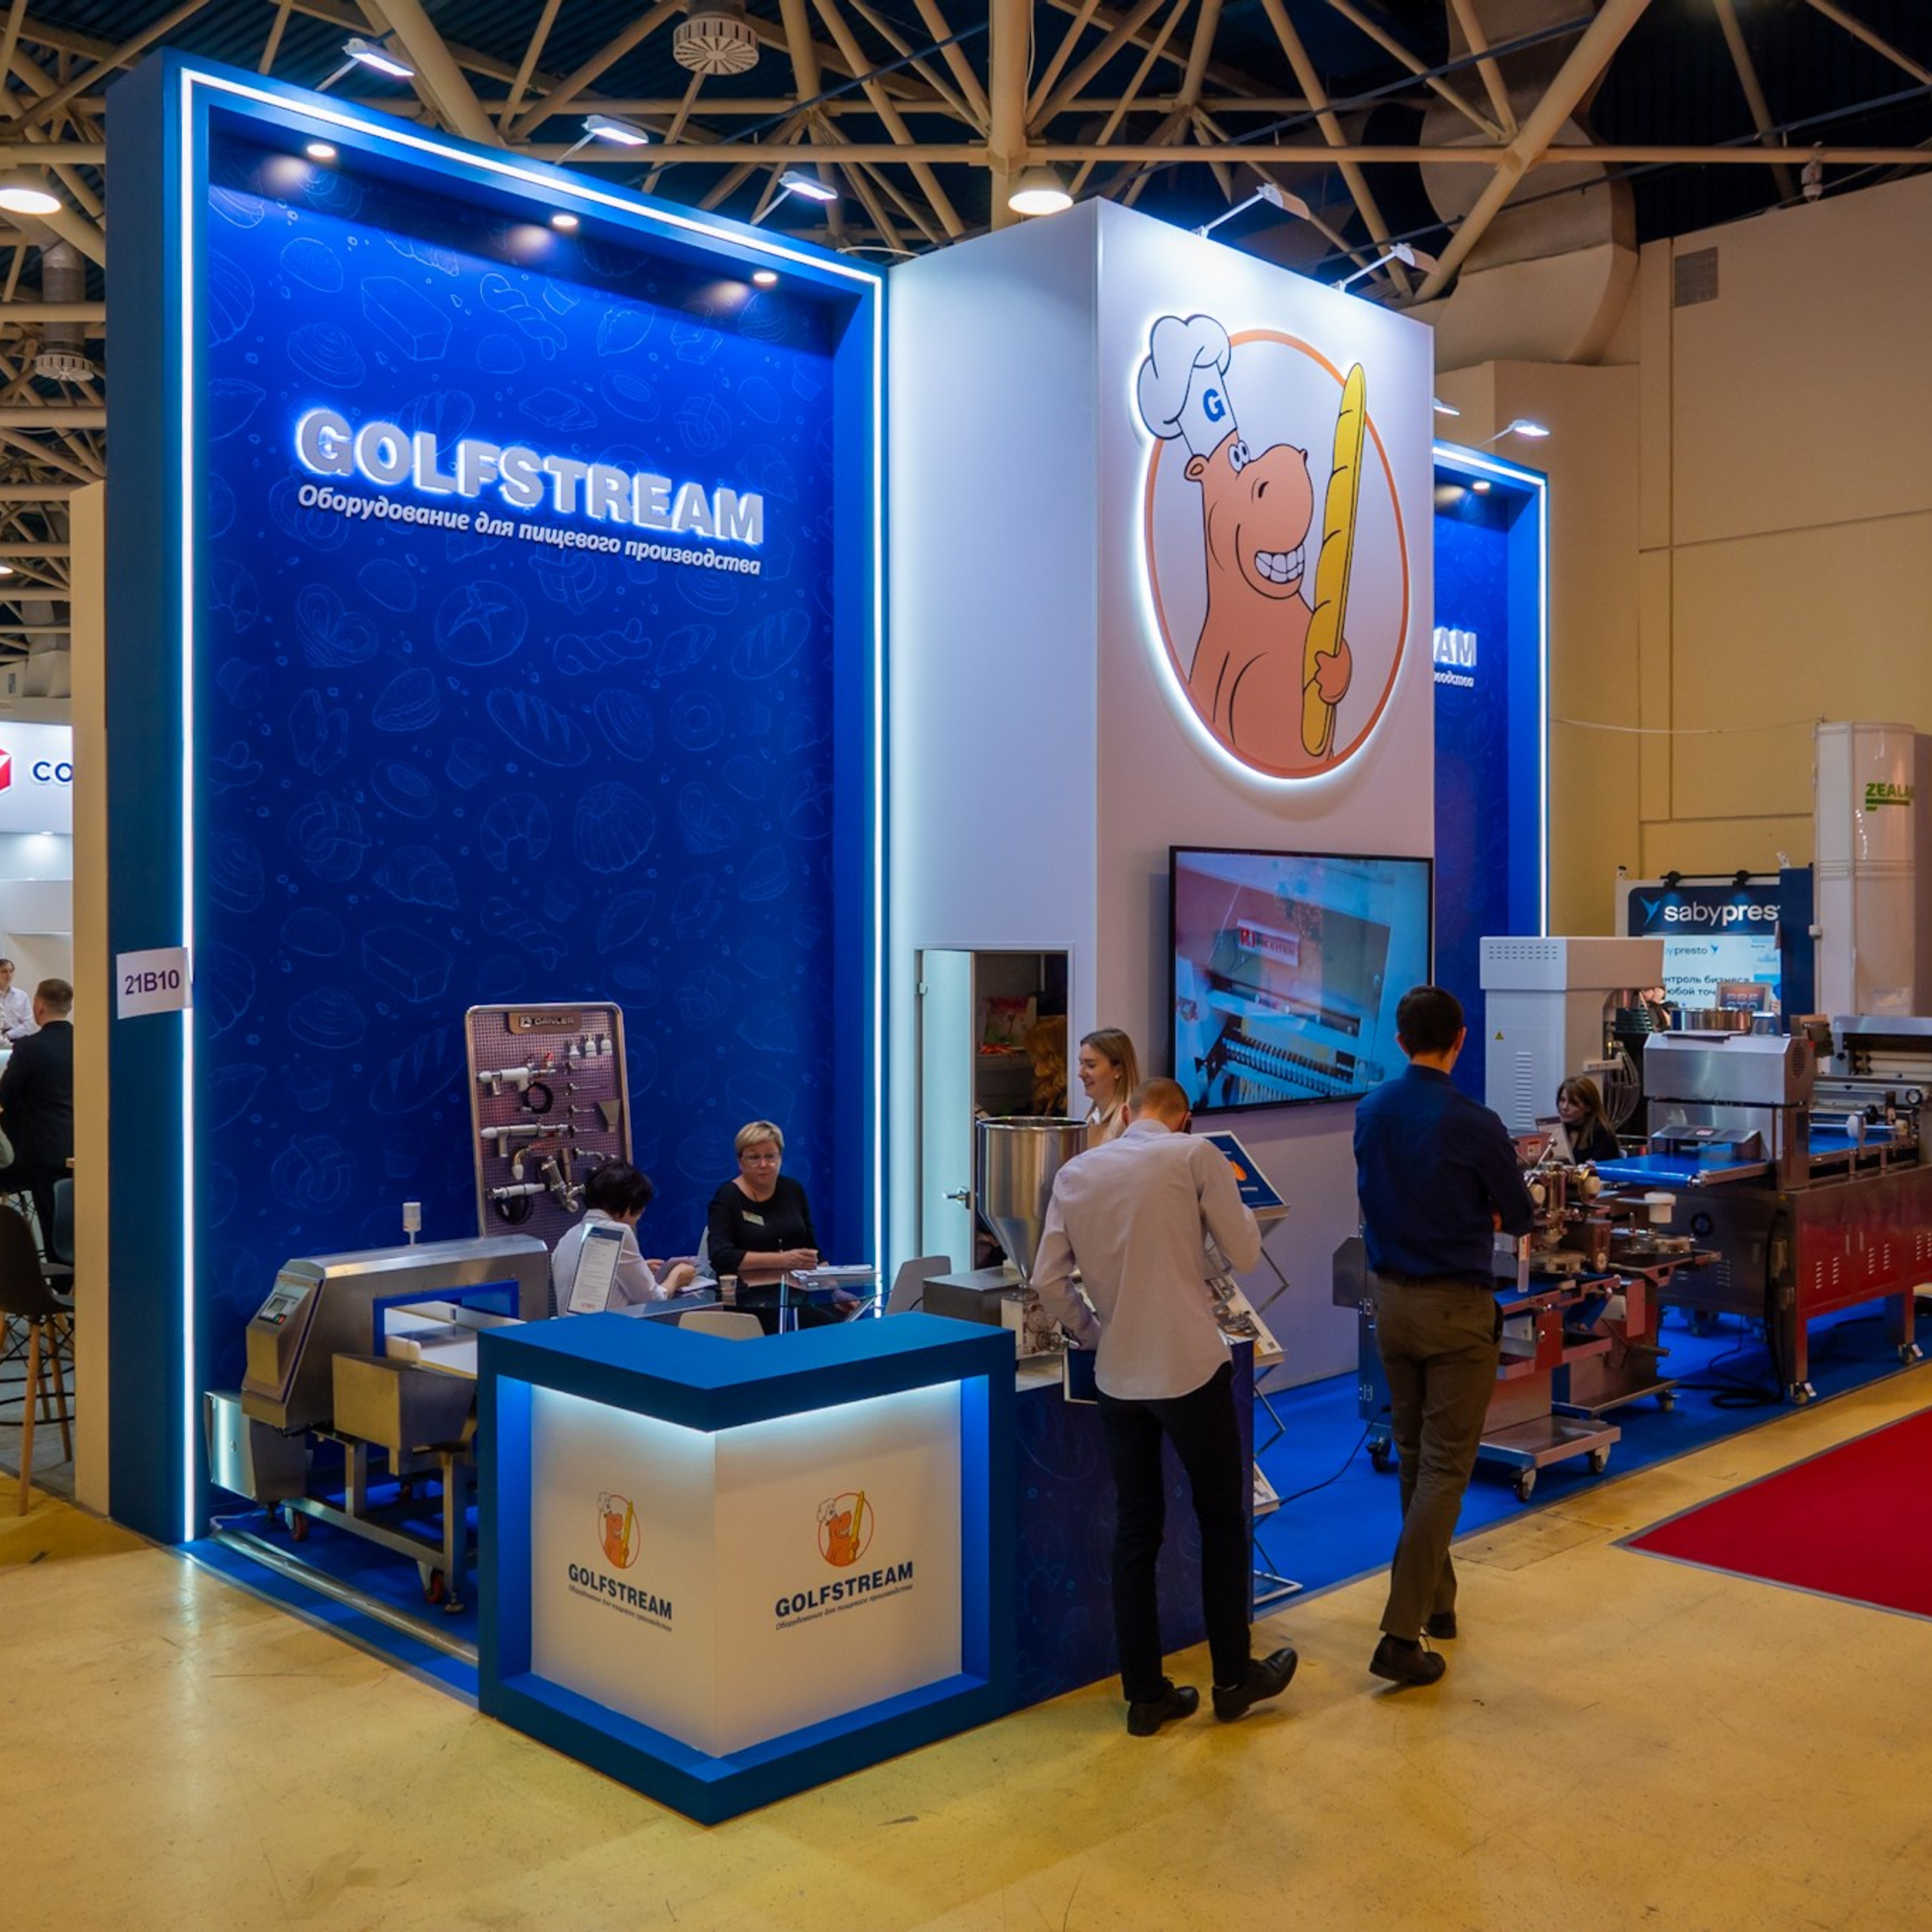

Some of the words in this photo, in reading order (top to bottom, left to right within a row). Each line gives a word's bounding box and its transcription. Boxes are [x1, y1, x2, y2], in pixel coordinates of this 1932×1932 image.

[1202, 388, 1226, 423] G
[296, 408, 764, 545] GOLFSTREAM
[298, 485, 471, 531] Оборудование
[475, 512, 514, 538] для
[518, 525, 621, 555] пищевого
[625, 541, 761, 575] производства
[1664, 901, 1781, 927] sabypres
[125, 970, 180, 995] 21B10
[1663, 976, 1701, 984] нтроль
[1667, 986, 1695, 995] юбой
[568, 1563, 672, 1620] GOLFSTREAM
[775, 1561, 913, 1617] GOLFSTREAM
